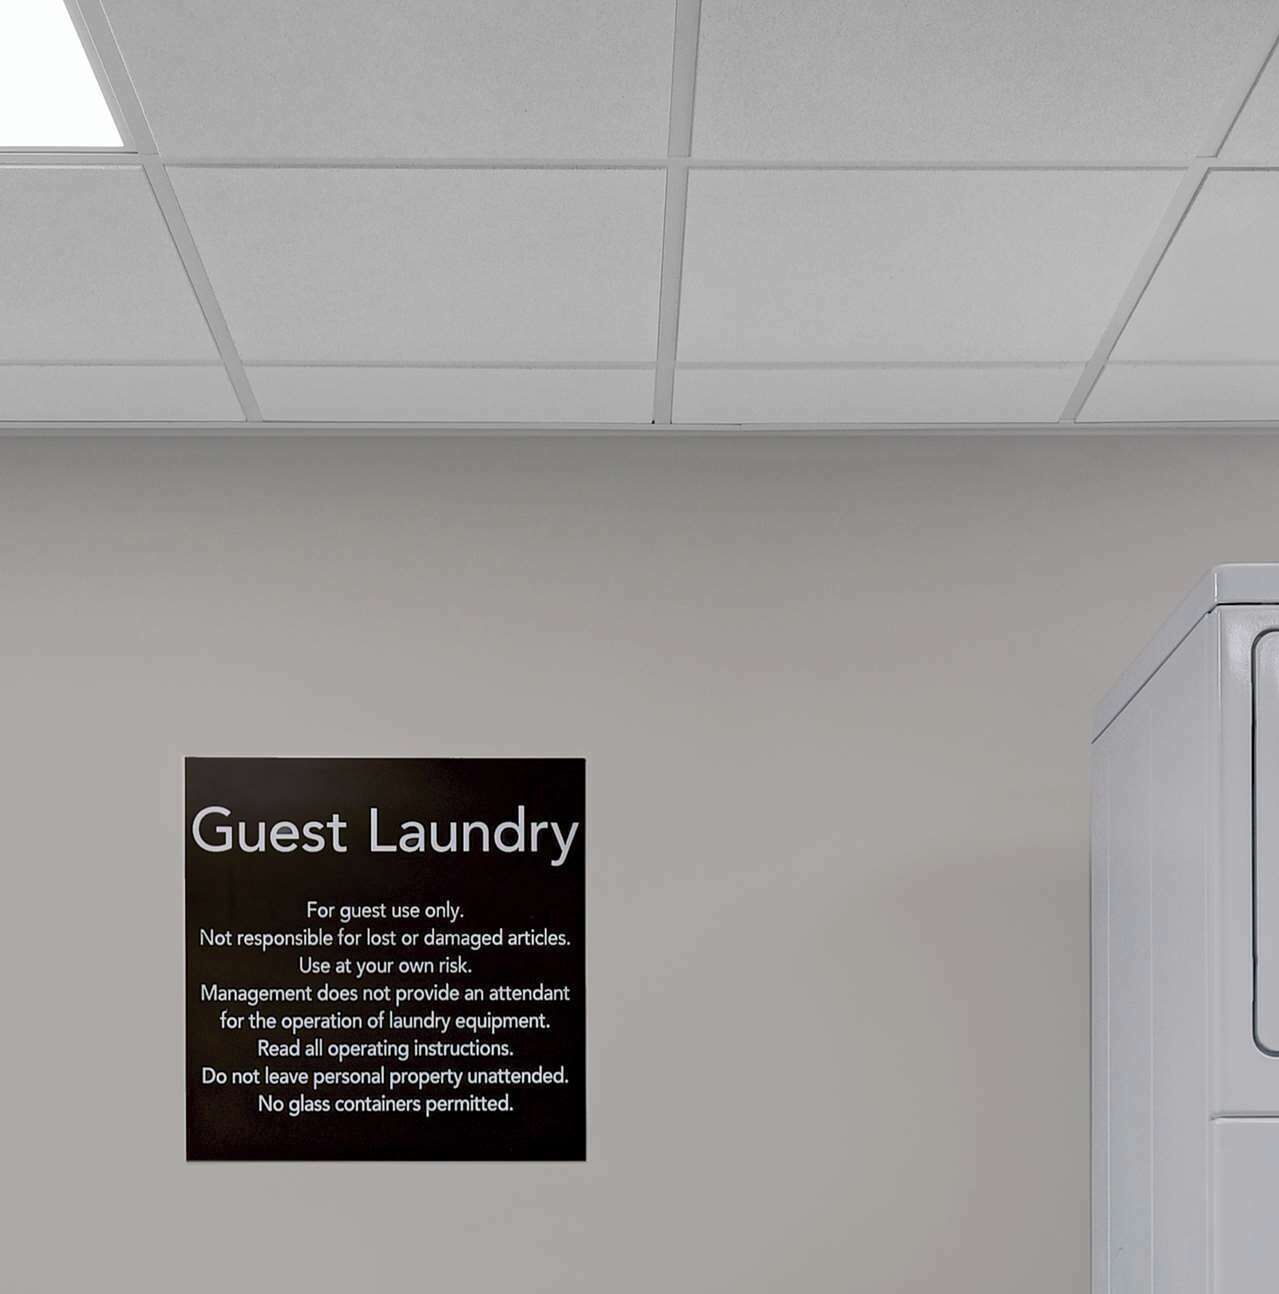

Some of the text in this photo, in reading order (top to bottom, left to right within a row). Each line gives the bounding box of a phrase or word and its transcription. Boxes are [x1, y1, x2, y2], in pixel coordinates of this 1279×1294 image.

[192, 804, 580, 867] Guest Laundry
[307, 899, 464, 922] For guest use only.
[200, 927, 571, 952] Not responsible for lost or damaged articles.
[299, 955, 472, 979] Use at your own risk.
[201, 982, 571, 1007] Management does not provide an attendant
[219, 1009, 551, 1035] for the operation of laundry equipment.
[258, 1038, 514, 1063] Read all operating instructions.
[202, 1064, 569, 1091] Do not leave personal property unattended.
[258, 1093, 514, 1118] No glass containers permitted.
